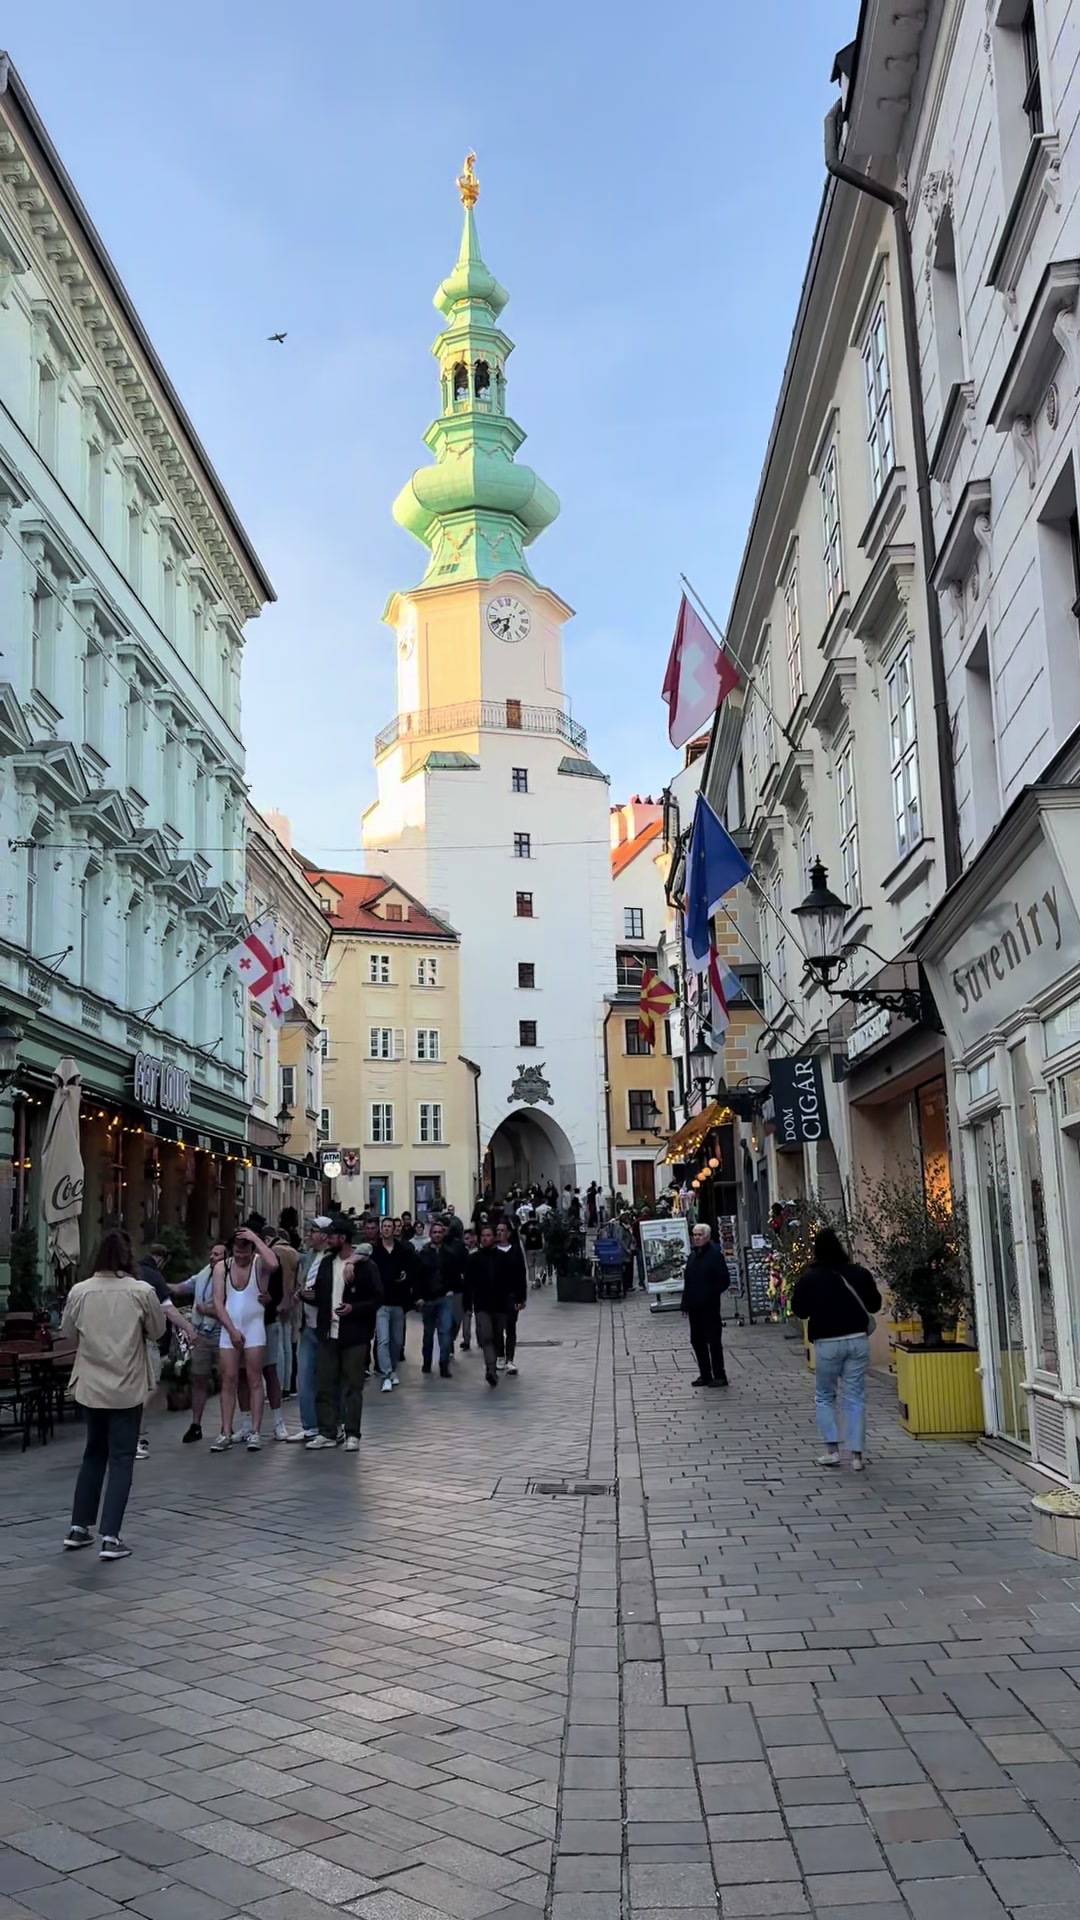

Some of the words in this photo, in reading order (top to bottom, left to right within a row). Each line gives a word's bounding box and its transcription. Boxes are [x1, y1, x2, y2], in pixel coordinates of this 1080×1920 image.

[160, 1061, 192, 1118] LOUIS
[792, 1058, 822, 1140] CIGÁR
[782, 1108, 797, 1141] DOM
[323, 1153, 340, 1161] ATM
